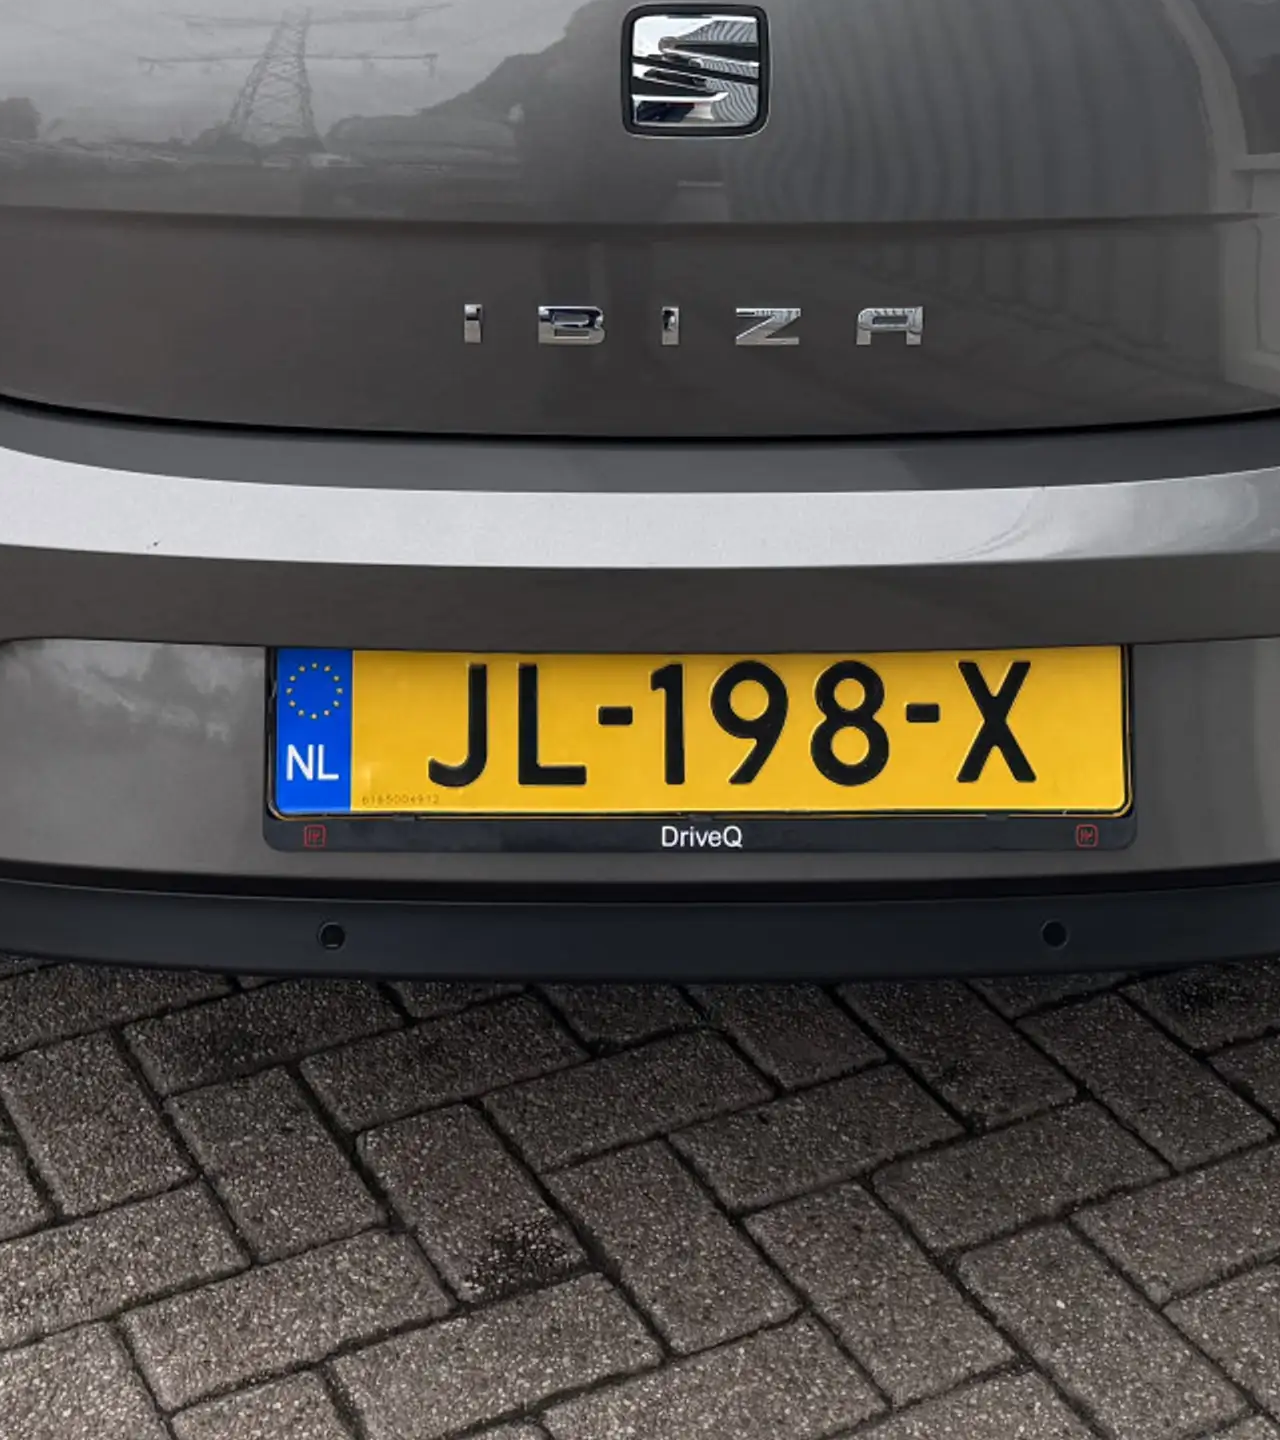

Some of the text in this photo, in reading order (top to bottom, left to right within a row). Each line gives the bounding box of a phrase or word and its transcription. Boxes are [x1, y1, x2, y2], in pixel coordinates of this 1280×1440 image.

[464, 303, 924, 346] IBIZA
[427, 659, 1037, 787] JL-198-X
[286, 743, 340, 781] NL
[661, 825, 743, 848] DriveQ
